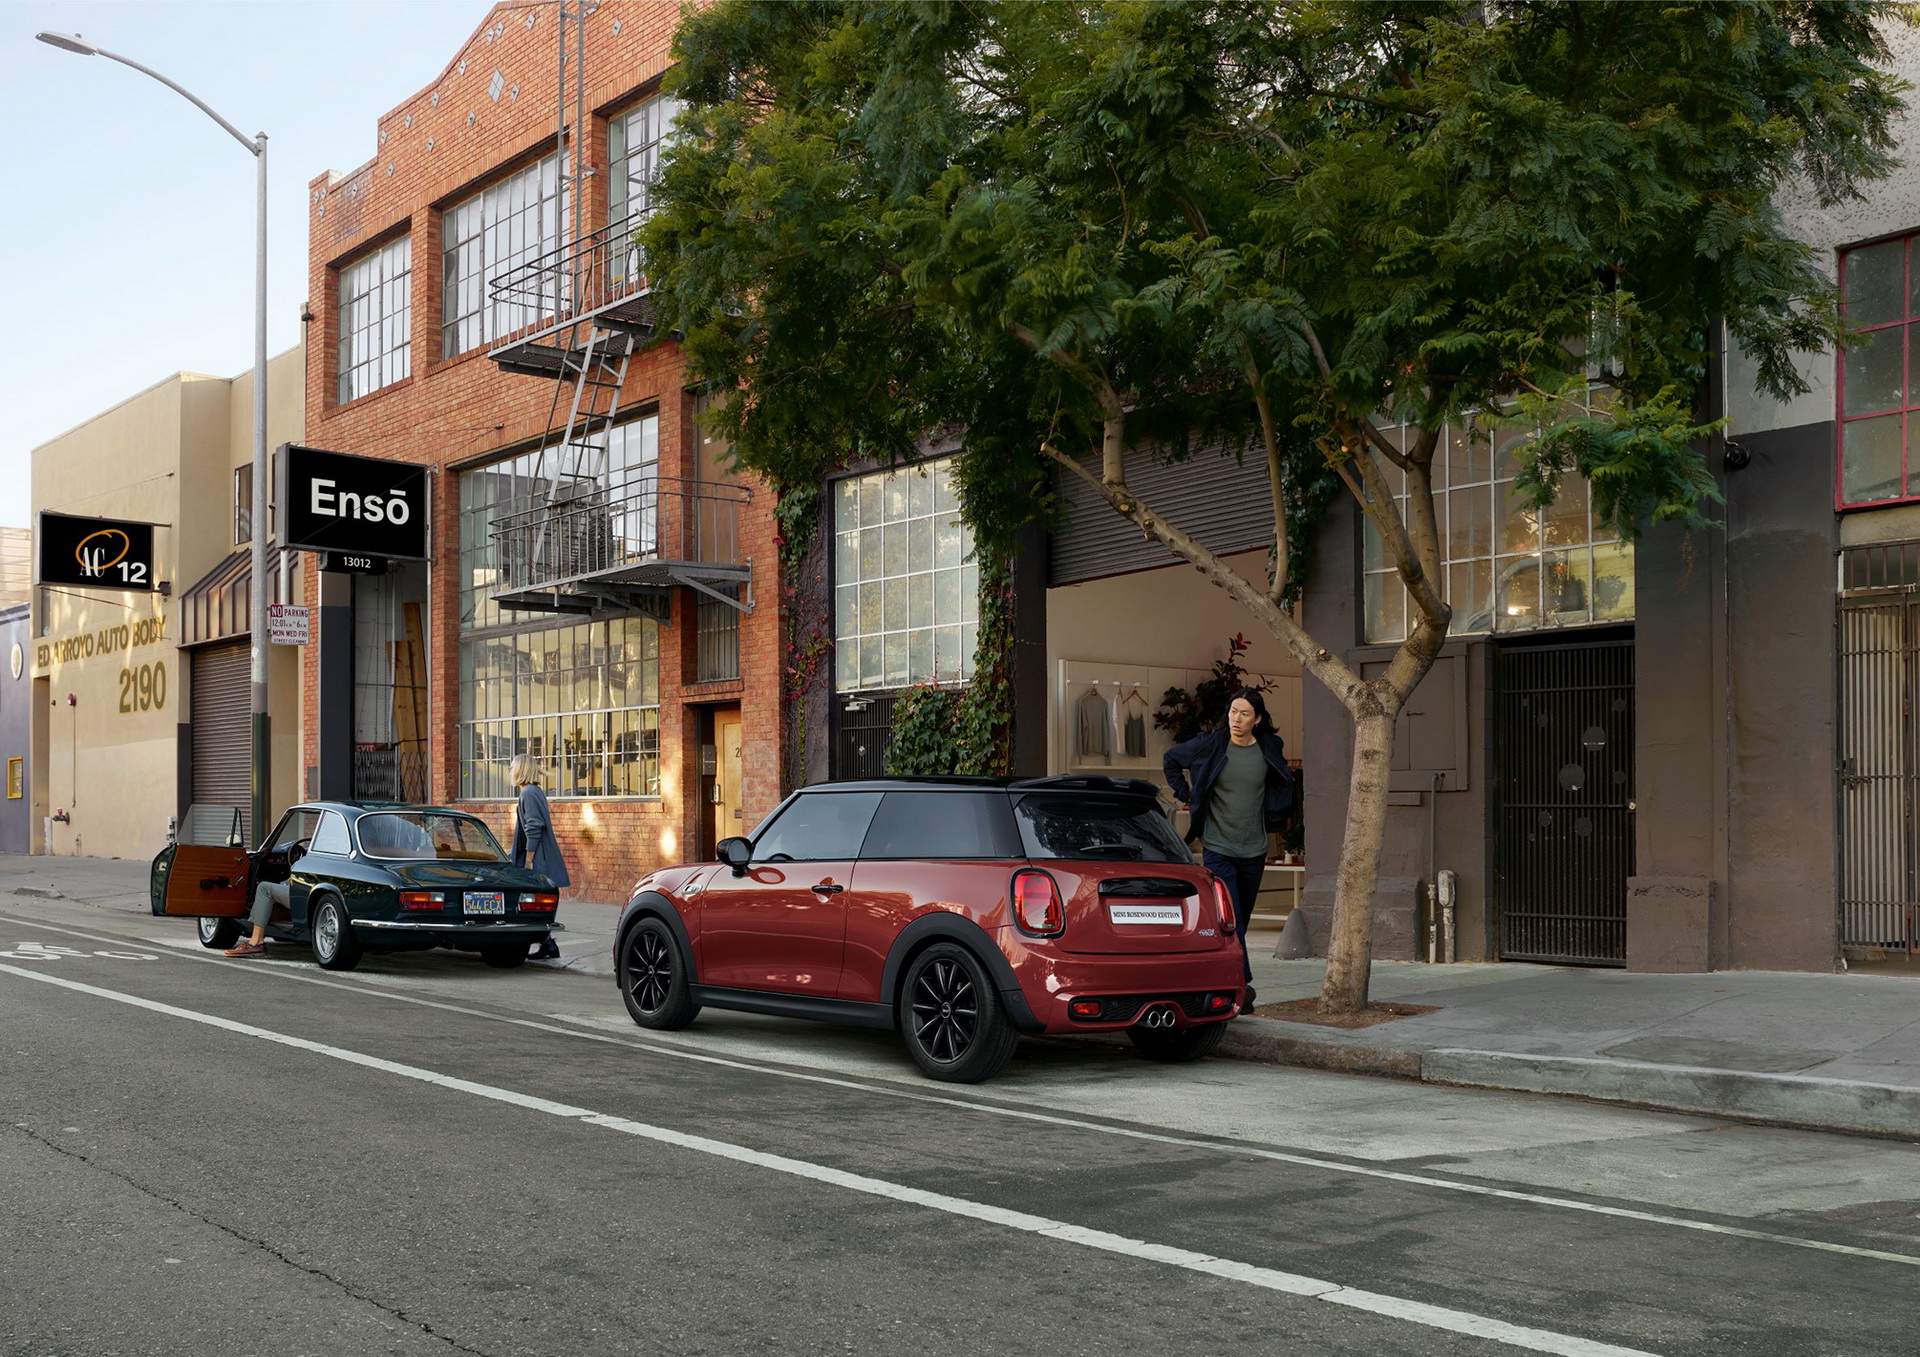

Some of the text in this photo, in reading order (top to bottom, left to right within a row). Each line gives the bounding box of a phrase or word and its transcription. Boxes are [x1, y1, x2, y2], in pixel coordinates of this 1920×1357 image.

[311, 477, 410, 525] Ensō
[343, 556, 371, 569] 13012
[117, 561, 147, 584] 12
[272, 606, 309, 617] NO PARKING
[286, 630, 297, 638] WED
[298, 630, 308, 638] FRI
[38, 615, 166, 669] ED ARROYO AUTO BODY
[119, 661, 167, 713] 2190
[466, 899, 502, 911] 544 ECX
[1113, 911, 1180, 919] MINI ROSEWOOD EDITION
